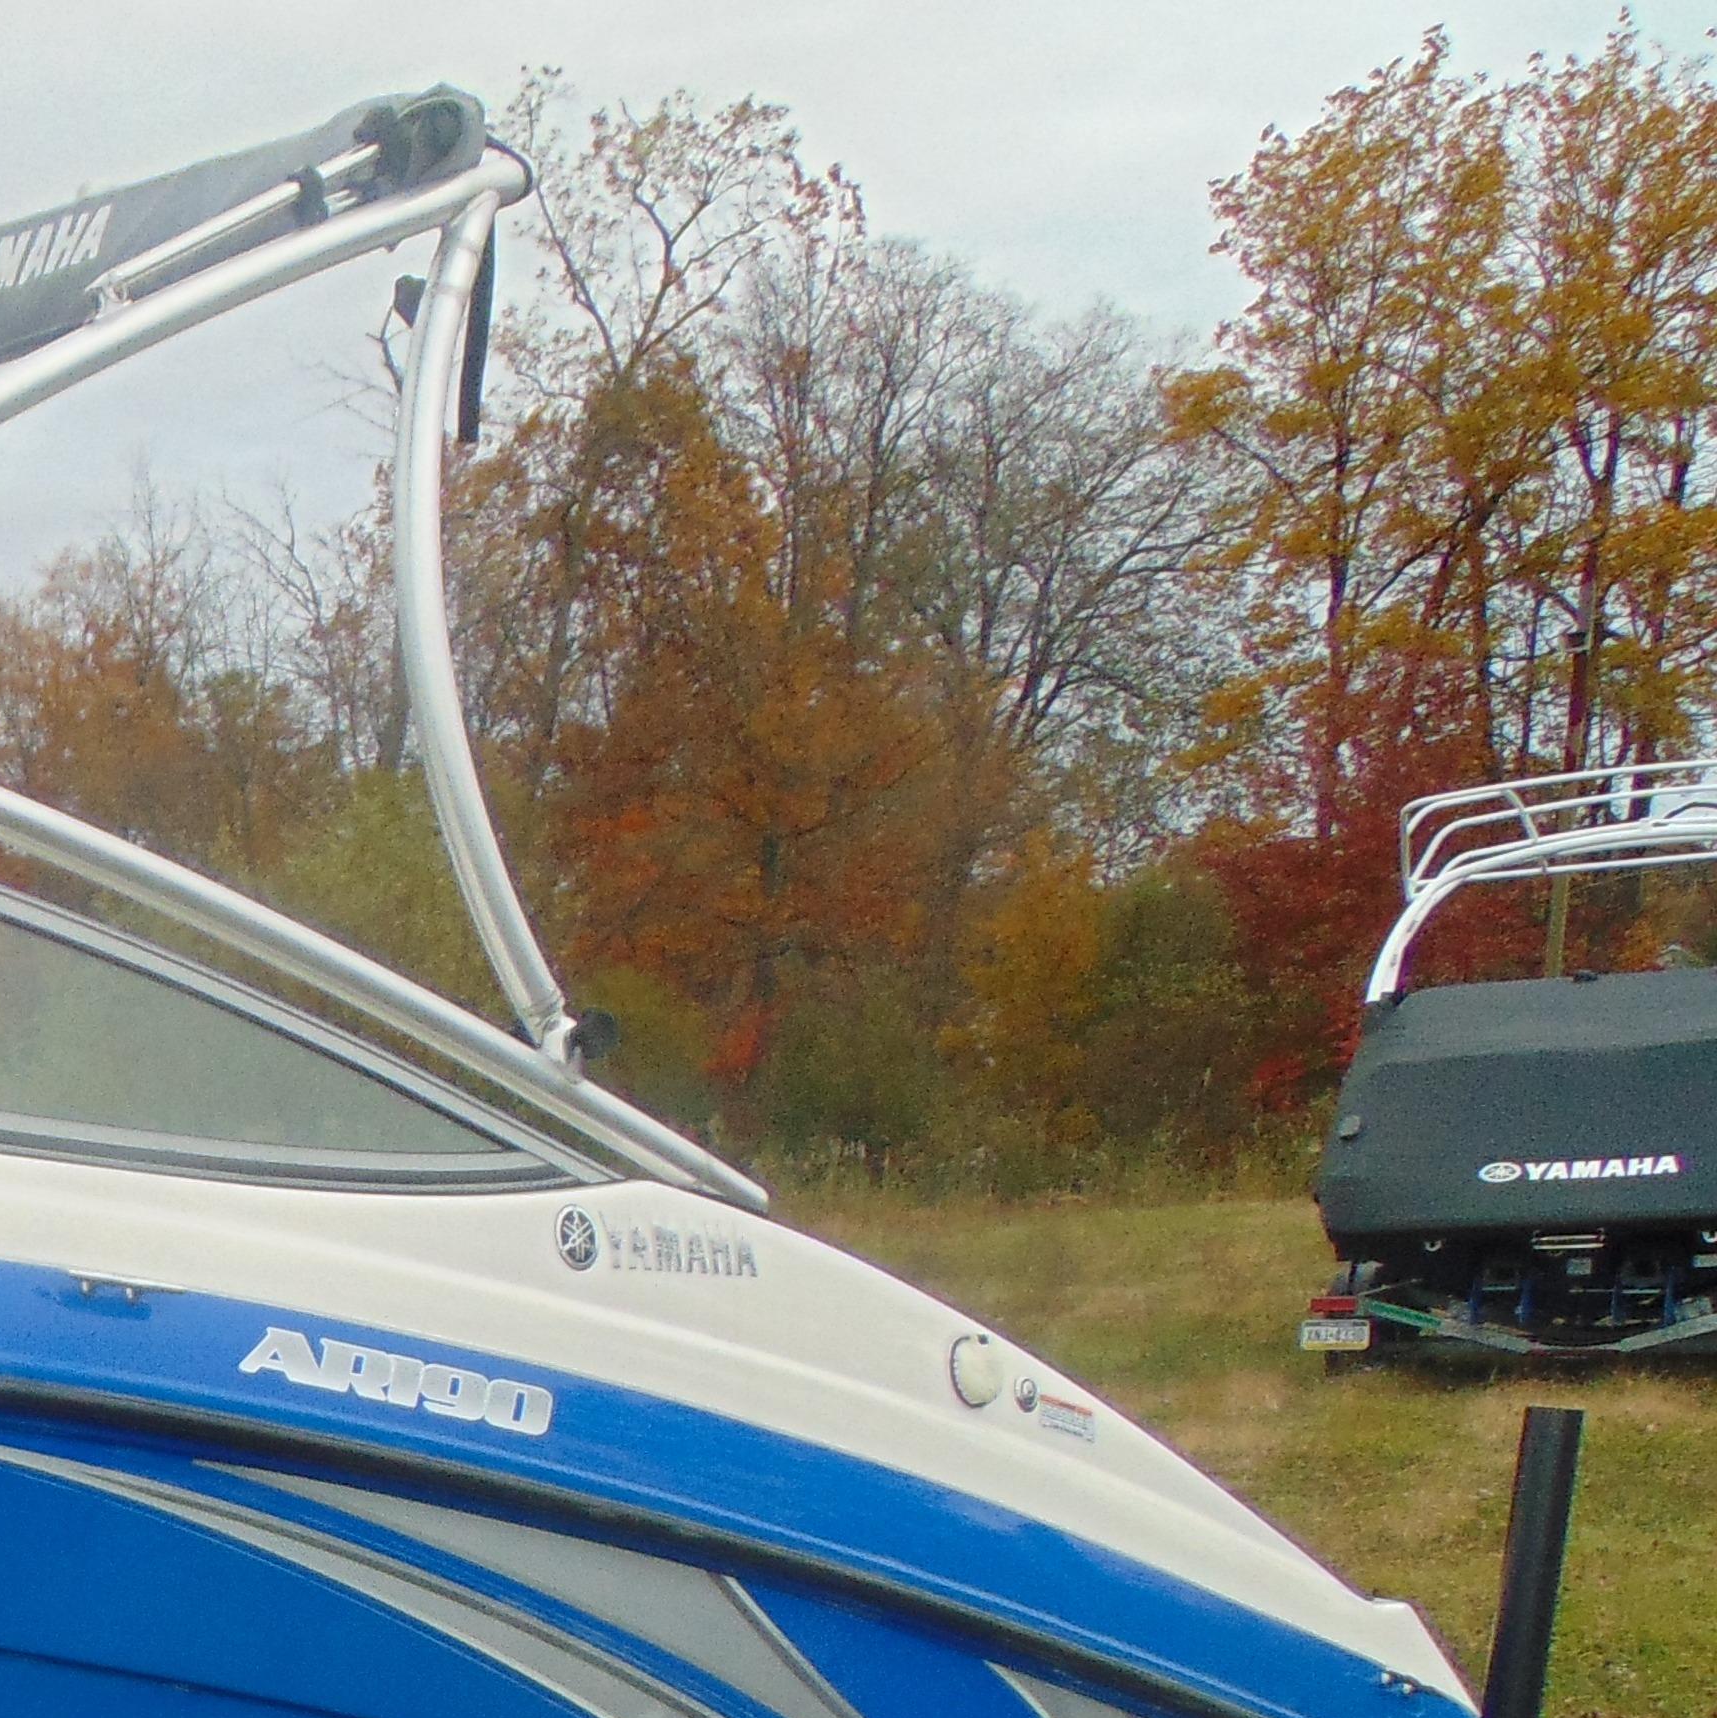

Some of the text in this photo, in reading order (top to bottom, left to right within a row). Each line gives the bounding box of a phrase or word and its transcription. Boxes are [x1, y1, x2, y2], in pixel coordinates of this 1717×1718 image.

[1524, 1155, 1681, 1181] YAMAHA
[598, 1211, 759, 1277] YAMAHA
[237, 1326, 554, 1436] AR190
